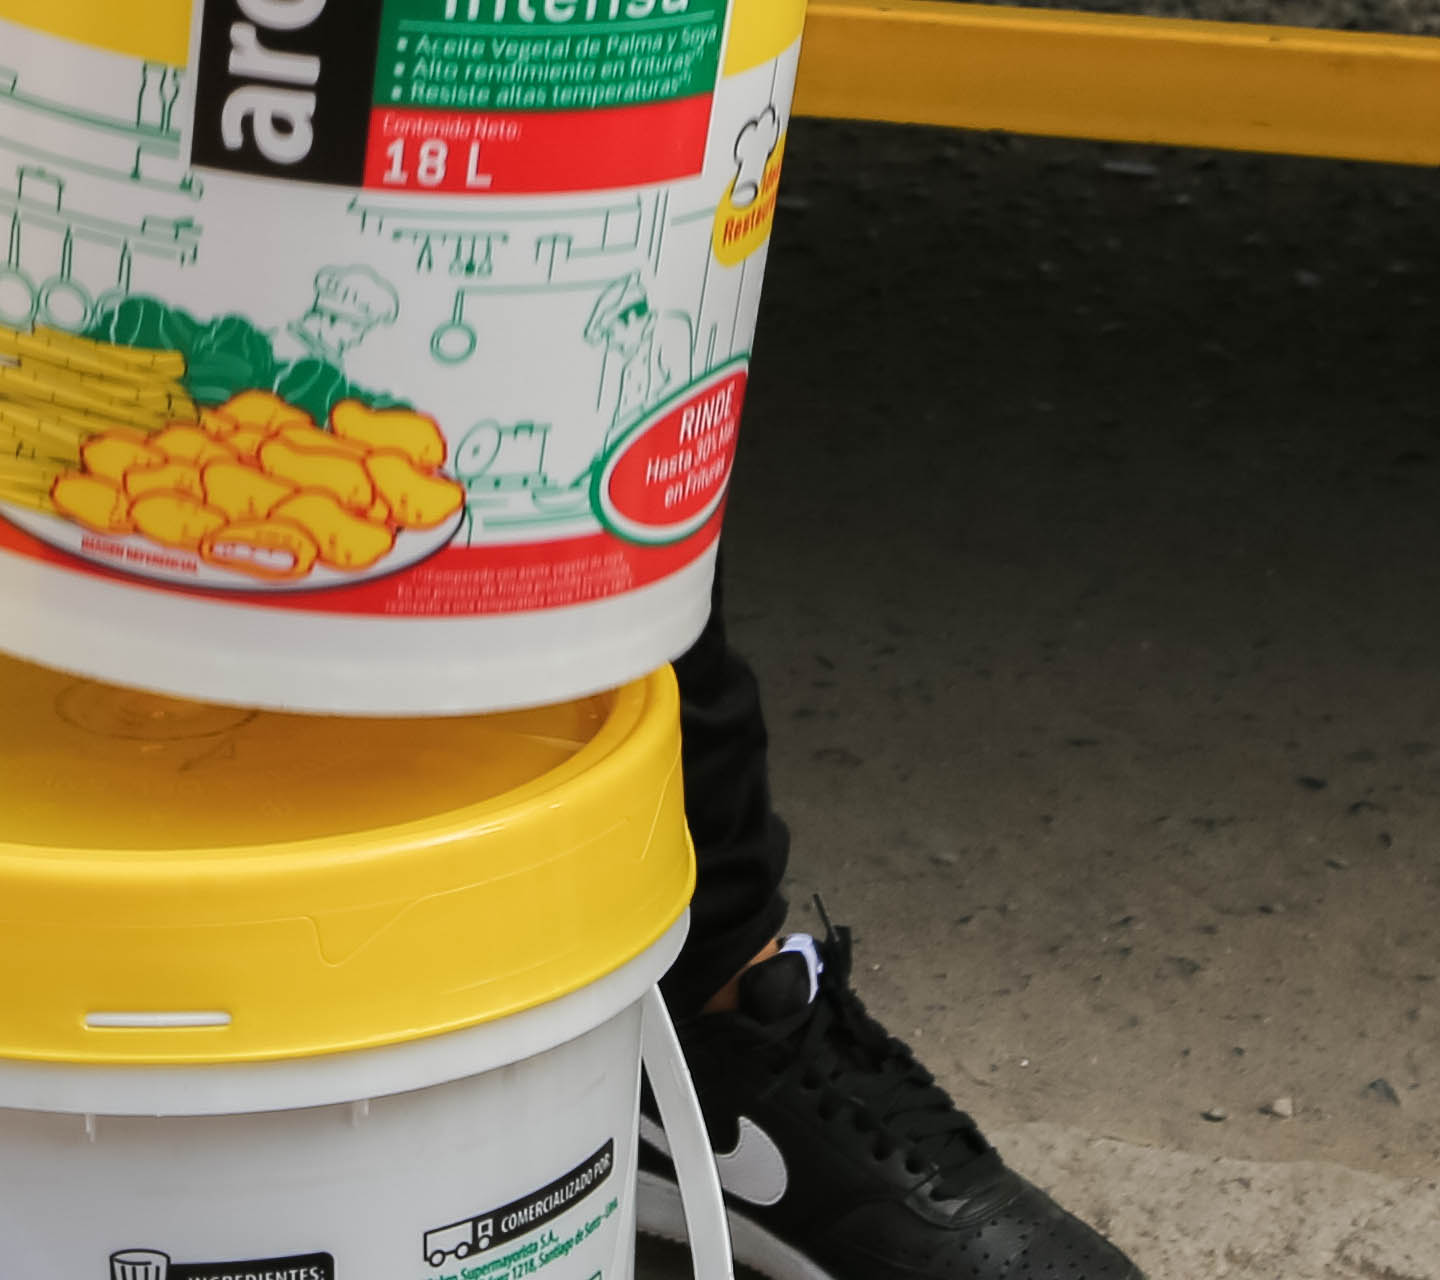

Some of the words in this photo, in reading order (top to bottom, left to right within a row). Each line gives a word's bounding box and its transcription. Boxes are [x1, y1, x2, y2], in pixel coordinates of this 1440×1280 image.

[415, 34, 485, 58] Aceite
[575, 36, 600, 58] de
[606, 32, 662, 56] Palma
[411, 57, 458, 81] Alto
[464, 60, 598, 84] rendimiento
[602, 61, 625, 78] en
[410, 84, 490, 106] Resiste
[496, 85, 547, 107] altas
[382, 112, 471, 138] Contenido
[382, 137, 450, 188] 18
[465, 140, 493, 189] L
[679, 379, 736, 445] RINDE
[645, 448, 693, 487] Hasta
[664, 481, 684, 509] en
[500, 1167, 594, 1233] COMERCIALIZADO
